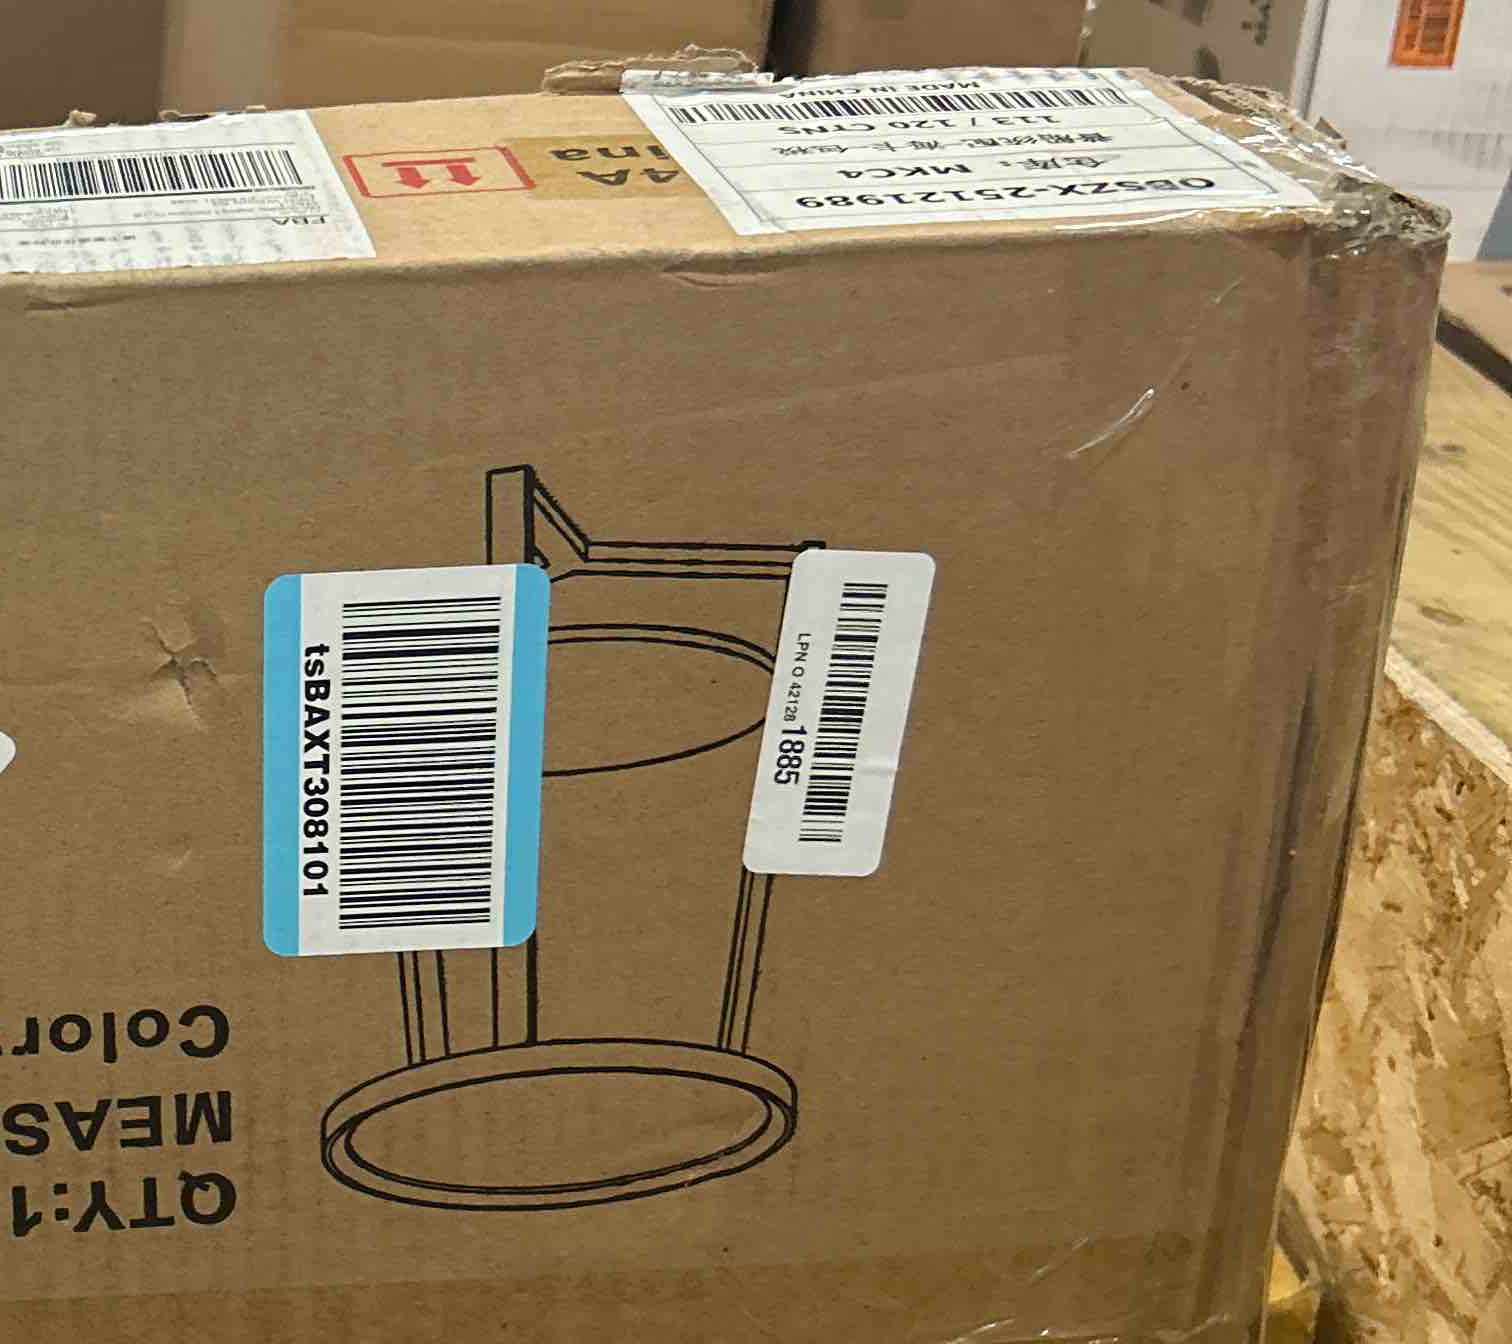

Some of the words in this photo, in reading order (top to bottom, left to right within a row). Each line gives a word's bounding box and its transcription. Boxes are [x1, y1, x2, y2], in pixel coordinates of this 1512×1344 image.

[871, 84, 897, 93] IN
[908, 80, 981, 91] MADE
[779, 87, 862, 99] CHINA
[888, 118, 956, 129] 120
[991, 114, 1061, 125] 113
[777, 122, 876, 135] CTNS
[838, 164, 973, 179] MKC4
[796, 632, 812, 663] LPN
[772, 725, 809, 787] 1885
[301, 642, 332, 898] tsBAXT308101
[9, 1169, 238, 1238] QTY:1
